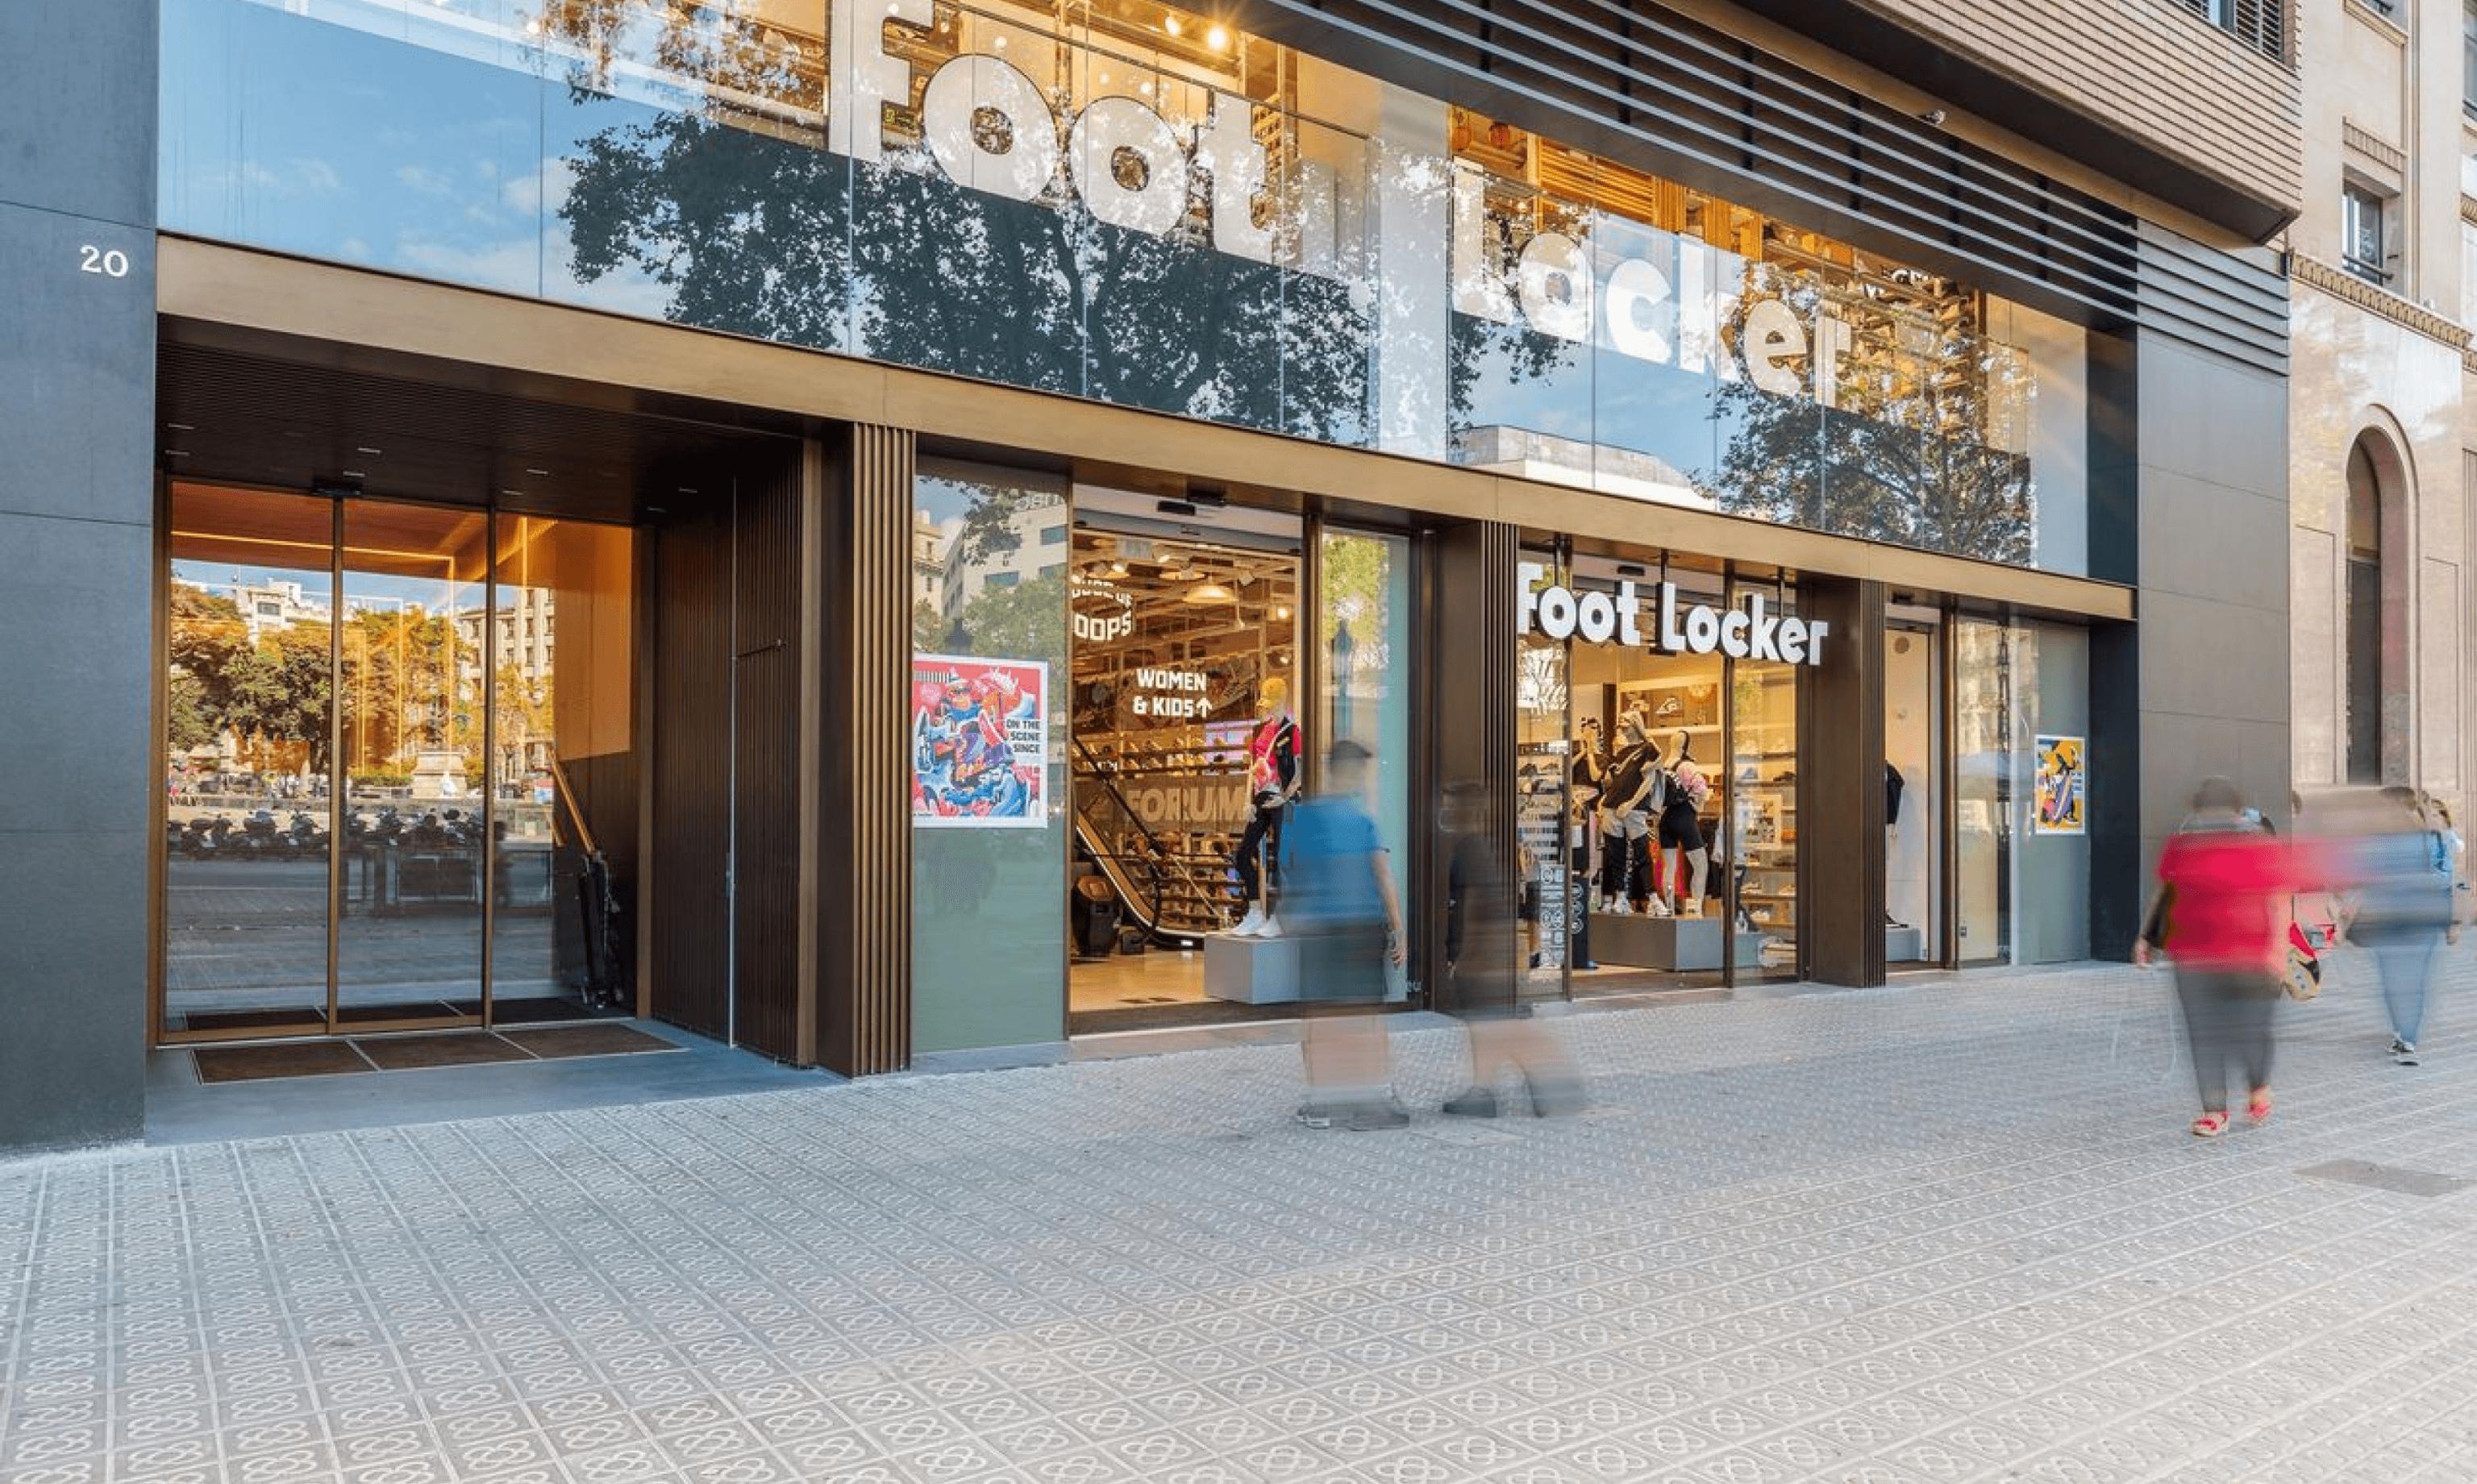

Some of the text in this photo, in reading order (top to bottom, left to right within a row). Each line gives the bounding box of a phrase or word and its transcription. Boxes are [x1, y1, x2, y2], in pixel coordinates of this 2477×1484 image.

[829, 0, 1852, 406] Foot Locker
[80, 244, 129, 277] 20
[1074, 610, 1132, 642] OOPS
[1517, 563, 1829, 666] Foot Locker
[1136, 668, 1207, 691] WOMEN
[1133, 695, 1194, 718] & KIDS
[1006, 718, 1040, 730] ON THE
[1010, 731, 1040, 741] SCENE
[1014, 743, 1040, 754] SINCE
[1126, 787, 1248, 822] FORUM
